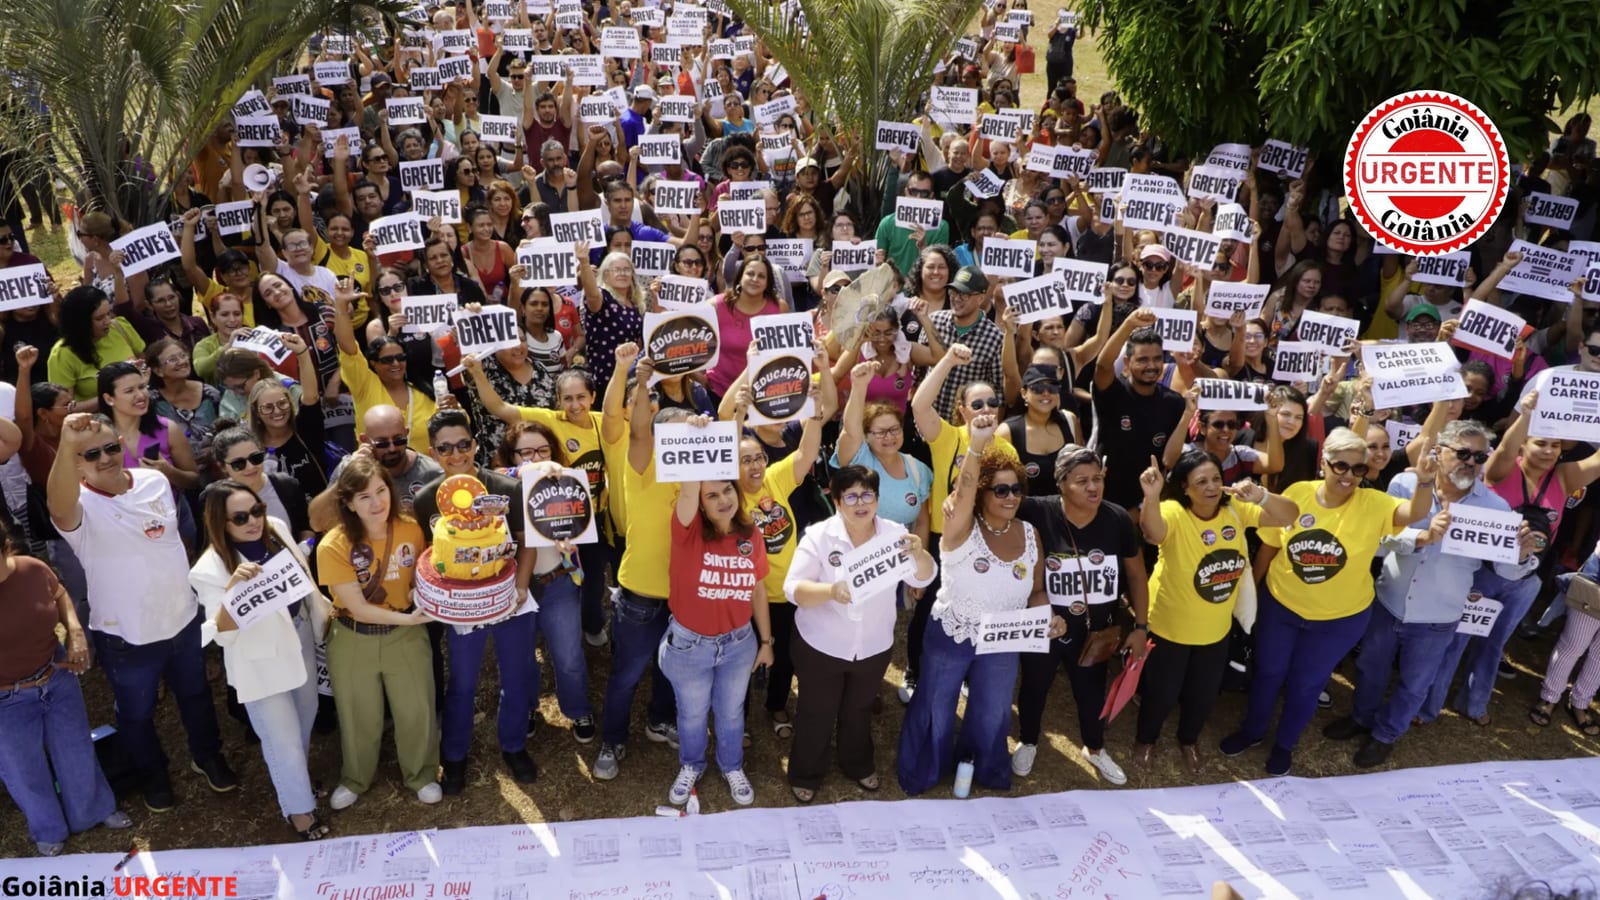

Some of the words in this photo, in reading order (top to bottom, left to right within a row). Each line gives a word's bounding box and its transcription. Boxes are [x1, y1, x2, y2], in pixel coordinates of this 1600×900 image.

[443, 35, 467, 47] GREVE
[503, 33, 527, 47] GREVE
[996, 26, 1017, 39] GREVE
[653, 47, 680, 62] GREVE
[317, 71, 346, 79] GREVE
[439, 58, 471, 77] GREVE
[532, 61, 560, 76] GREVE
[276, 80, 304, 95] GREVE
[388, 104, 417, 119] GREVE
[581, 102, 609, 117] GREVE
[660, 101, 689, 116] GREVE
[238, 125, 272, 140] GREVE
[482, 121, 509, 136] GREVE
[878, 128, 909, 145] GREVE
[982, 118, 1017, 139] GREVE
[325, 137, 360, 149] GVE
[640, 142, 671, 157] GREVE
[761, 133, 791, 149] GREVE
[1031, 156, 1051, 167] GRE
[1053, 154, 1086, 174] GREVE
[1209, 158, 1248, 170] GREVE
[1260, 145, 1307, 173] GREVE
[402, 166, 443, 188] GREVE
[1131, 178, 1164, 188] PLANO
[1192, 173, 1228, 196] GREVE
[415, 197, 451, 217] GREVE
[897, 205, 932, 225] GREVE
[1126, 200, 1166, 222] GREVE
[1535, 200, 1574, 221] GREVE
[720, 209, 756, 227] GREVE
[1217, 211, 1248, 232] GREVE
[372, 222, 411, 245] GREVE
[554, 219, 594, 243] GREVE
[833, 247, 868, 265] GREVE
[1165, 232, 1219, 265] GREVE
[1520, 246, 1557, 262] PLANO
[1560, 256, 1575, 266] DE
[520, 253, 576, 280] GREVE
[984, 247, 1024, 269] GREVE
[1523, 256, 1572, 272] ARREIRA
[1417, 257, 1458, 278] GREVE
[0, 275, 36, 301] REVE
[659, 282, 696, 304] GREVE
[1213, 291, 1252, 299] EDUCAÇÃO
[1008, 285, 1057, 314] GREVE
[1211, 300, 1260, 311] GREVE
[404, 306, 446, 325] GREVE
[457, 311, 517, 347] GREVE
[754, 323, 801, 351] GREVE
[1301, 320, 1344, 347] GREVE
[1460, 310, 1511, 349] GREVE
[650, 326, 713, 353] EDUCAÇÃO
[666, 342, 708, 358] GREVE
[1375, 351, 1417, 360] PLANO
[1277, 350, 1312, 373] GREVE
[1378, 356, 1443, 369] CARREIRA
[753, 366, 807, 392] EDUCAÇÃO
[1378, 375, 1455, 391] VALORIZAÇÃO
[1552, 376, 1600, 390] PLANO
[766, 380, 802, 396] GREVE
[1550, 388, 1600, 400] CARRE
[661, 436, 715, 446] EDUCAÇÃO
[662, 449, 733, 465] GREVE
[528, 485, 586, 508] EDUCAÇÃO
[534, 509, 544, 517] EM
[546, 501, 584, 516] GREVE
[1452, 516, 1502, 530] EDUCAÇÃO
[1450, 528, 1516, 549] GREVE
[849, 546, 891, 573] EDUCAÇÃO
[893, 539, 906, 552] EM
[1288, 540, 1343, 556] EDUCAÇÃO
[1301, 552, 1337, 564] GREVE
[852, 552, 910, 589] GREVE
[1198, 556, 1244, 578] EDUCAÇÃO
[230, 572, 279, 606] EDUCAÇÃO
[280, 562, 294, 576] EM
[700, 571, 721, 585] NA
[722, 572, 755, 586] LUTA
[1049, 569, 1102, 596] GREVE
[237, 573, 303, 618] GREVE
[698, 586, 753, 601] SEMPRE
[984, 620, 1033, 629] EDUCAÇÃO
[1035, 618, 1048, 626] EM
[1461, 613, 1492, 626] EVE
[983, 628, 1046, 643] GREVE
